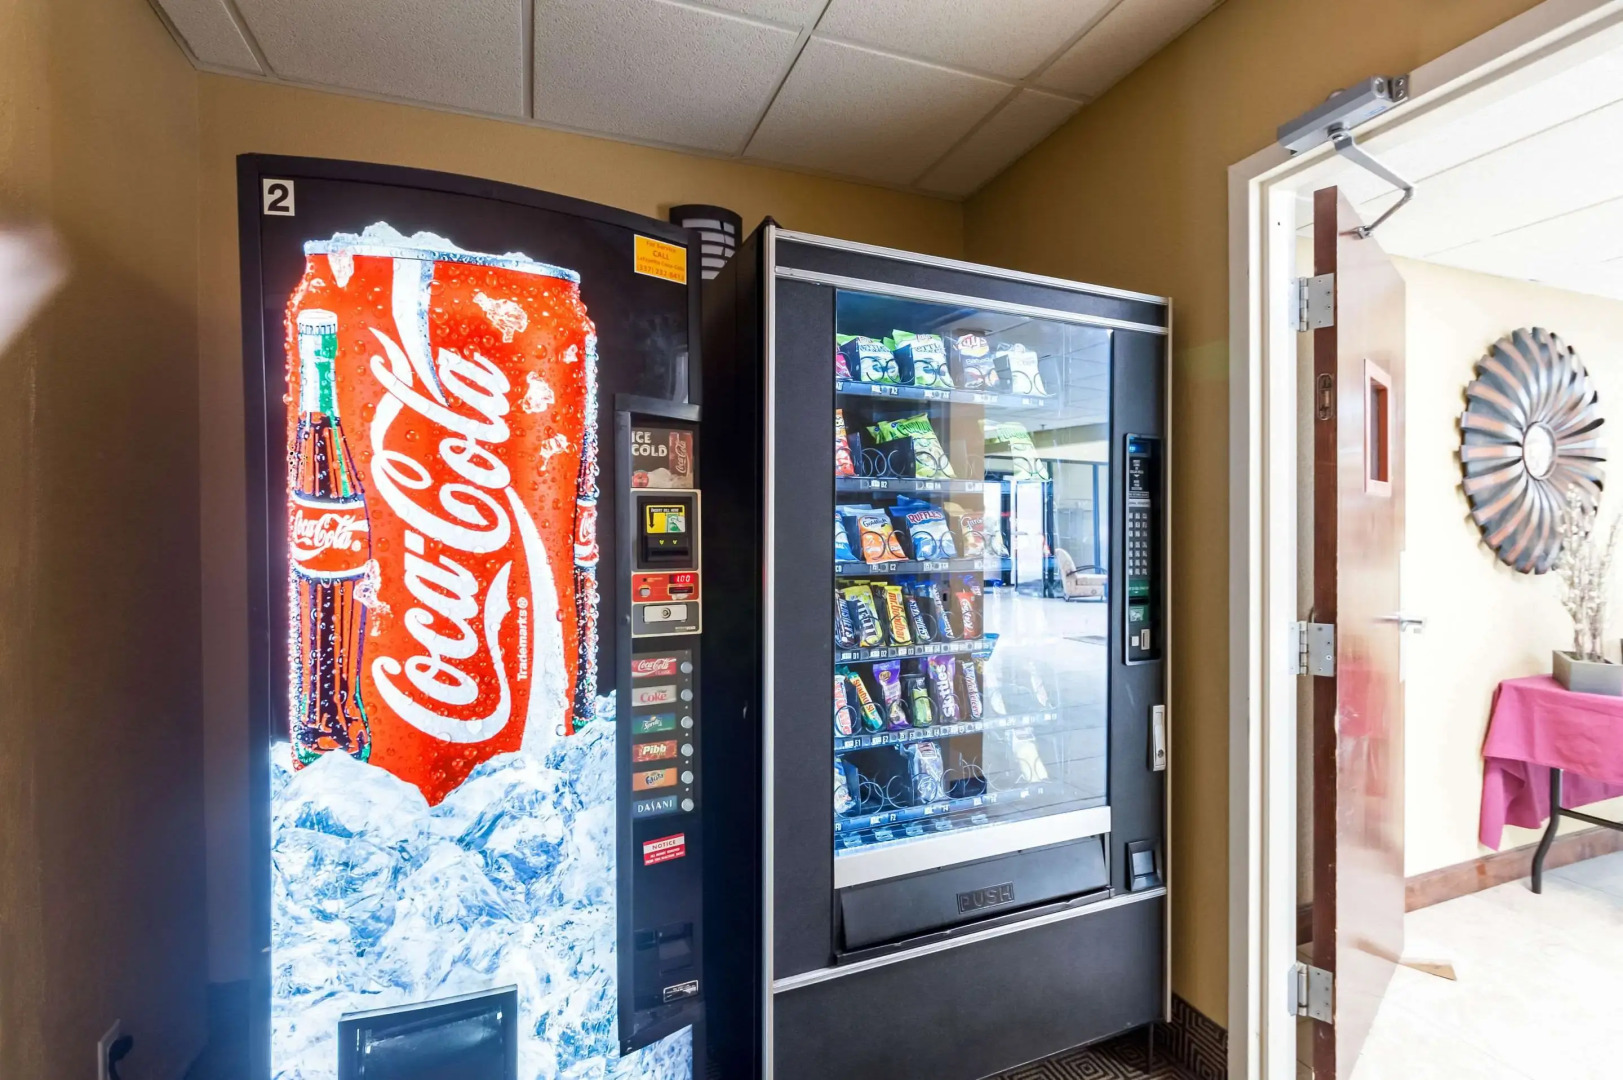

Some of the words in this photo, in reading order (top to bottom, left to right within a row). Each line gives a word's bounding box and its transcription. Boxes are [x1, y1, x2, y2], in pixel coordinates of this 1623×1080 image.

[267, 183, 290, 212] 2
[653, 251, 669, 260] CALL
[632, 431, 652, 443] ICE
[632, 444, 668, 457] COLD
[907, 511, 943, 524] RUFFLES
[292, 509, 354, 550] Coca-Cola
[369, 336, 511, 743] Coca-Cola
[638, 659, 669, 671] Coca-Cola
[640, 692, 667, 703] Coke
[642, 744, 667, 755] Pibb
[637, 799, 673, 813] DASANI
[652, 840, 676, 850] NOTICE
[962, 884, 1013, 911] PUSH
